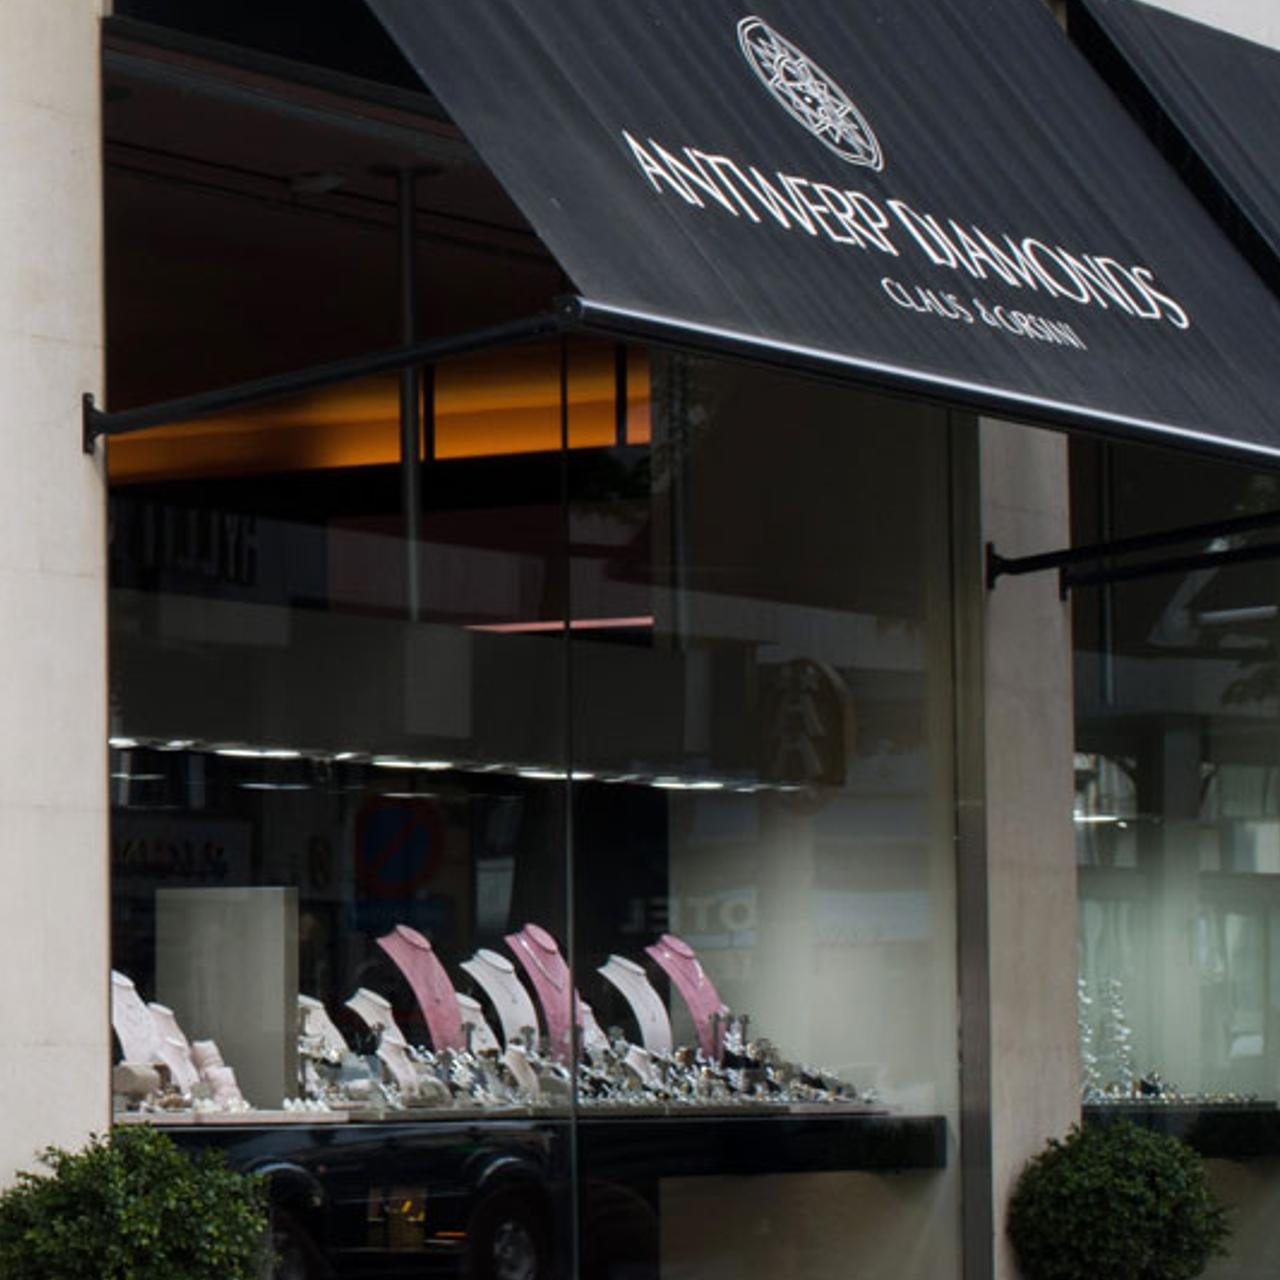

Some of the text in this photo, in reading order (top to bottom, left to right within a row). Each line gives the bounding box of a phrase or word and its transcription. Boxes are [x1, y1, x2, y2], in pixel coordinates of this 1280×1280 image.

[622, 129, 1190, 329] ANTWERP DIAMONDS
[881, 277, 974, 323] CLAUS
